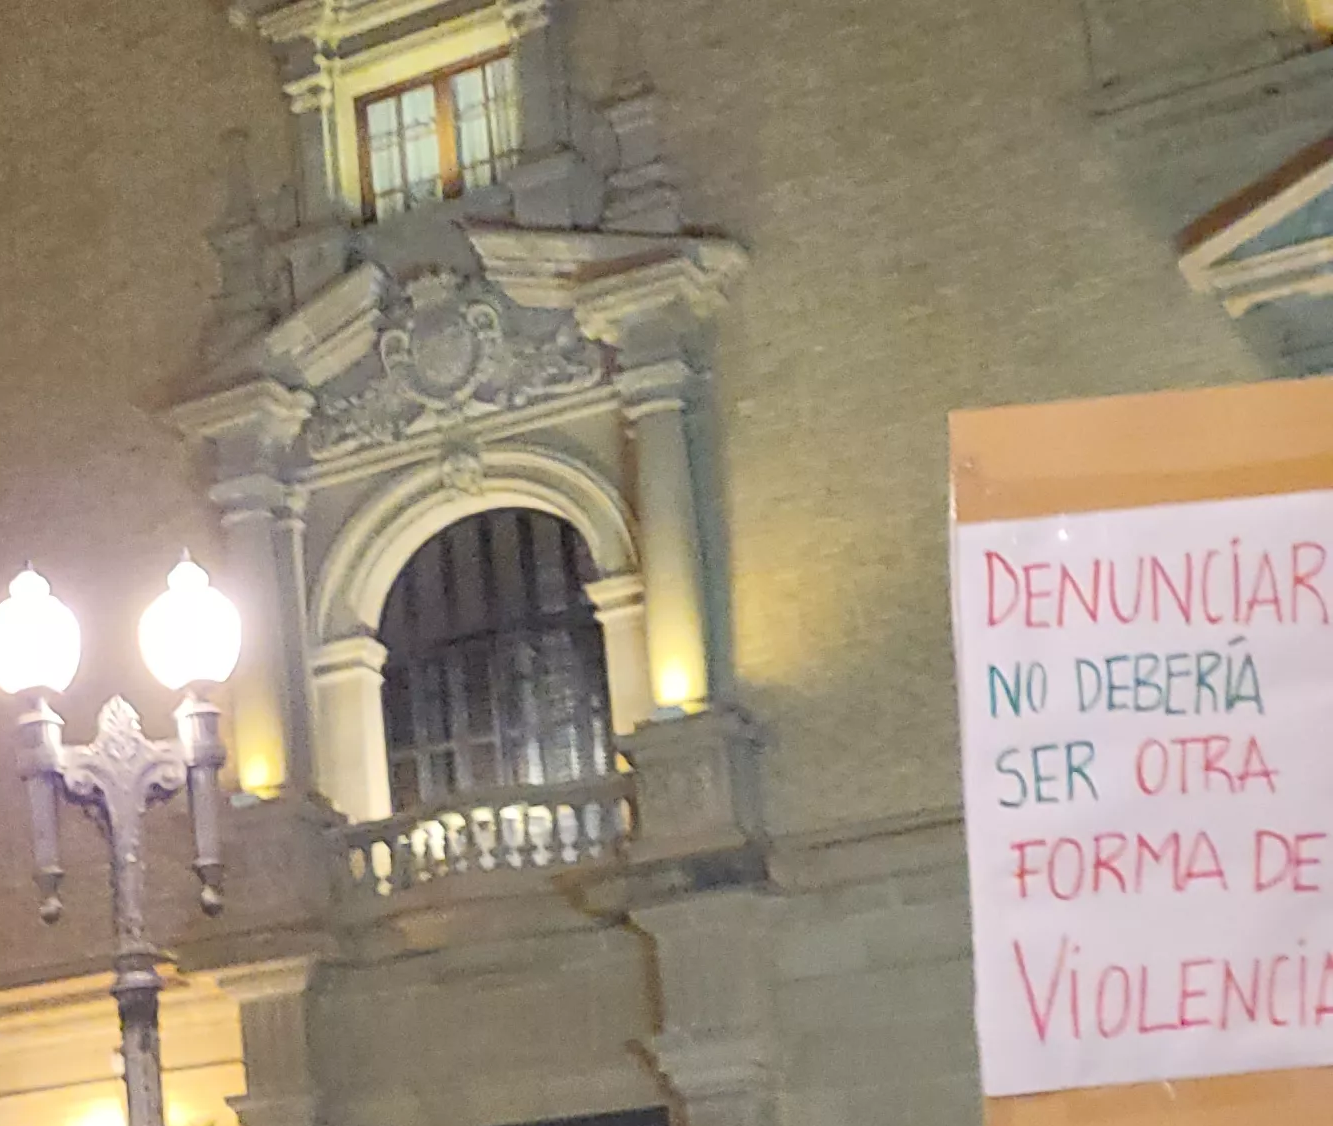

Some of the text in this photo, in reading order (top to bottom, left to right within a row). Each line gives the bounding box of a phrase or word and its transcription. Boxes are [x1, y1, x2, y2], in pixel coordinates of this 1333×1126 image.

[988, 635, 1265, 718] NO DEBERÍA
[995, 735, 1279, 807] SER OTRA
[1010, 828, 1327, 900] FORMA DE
